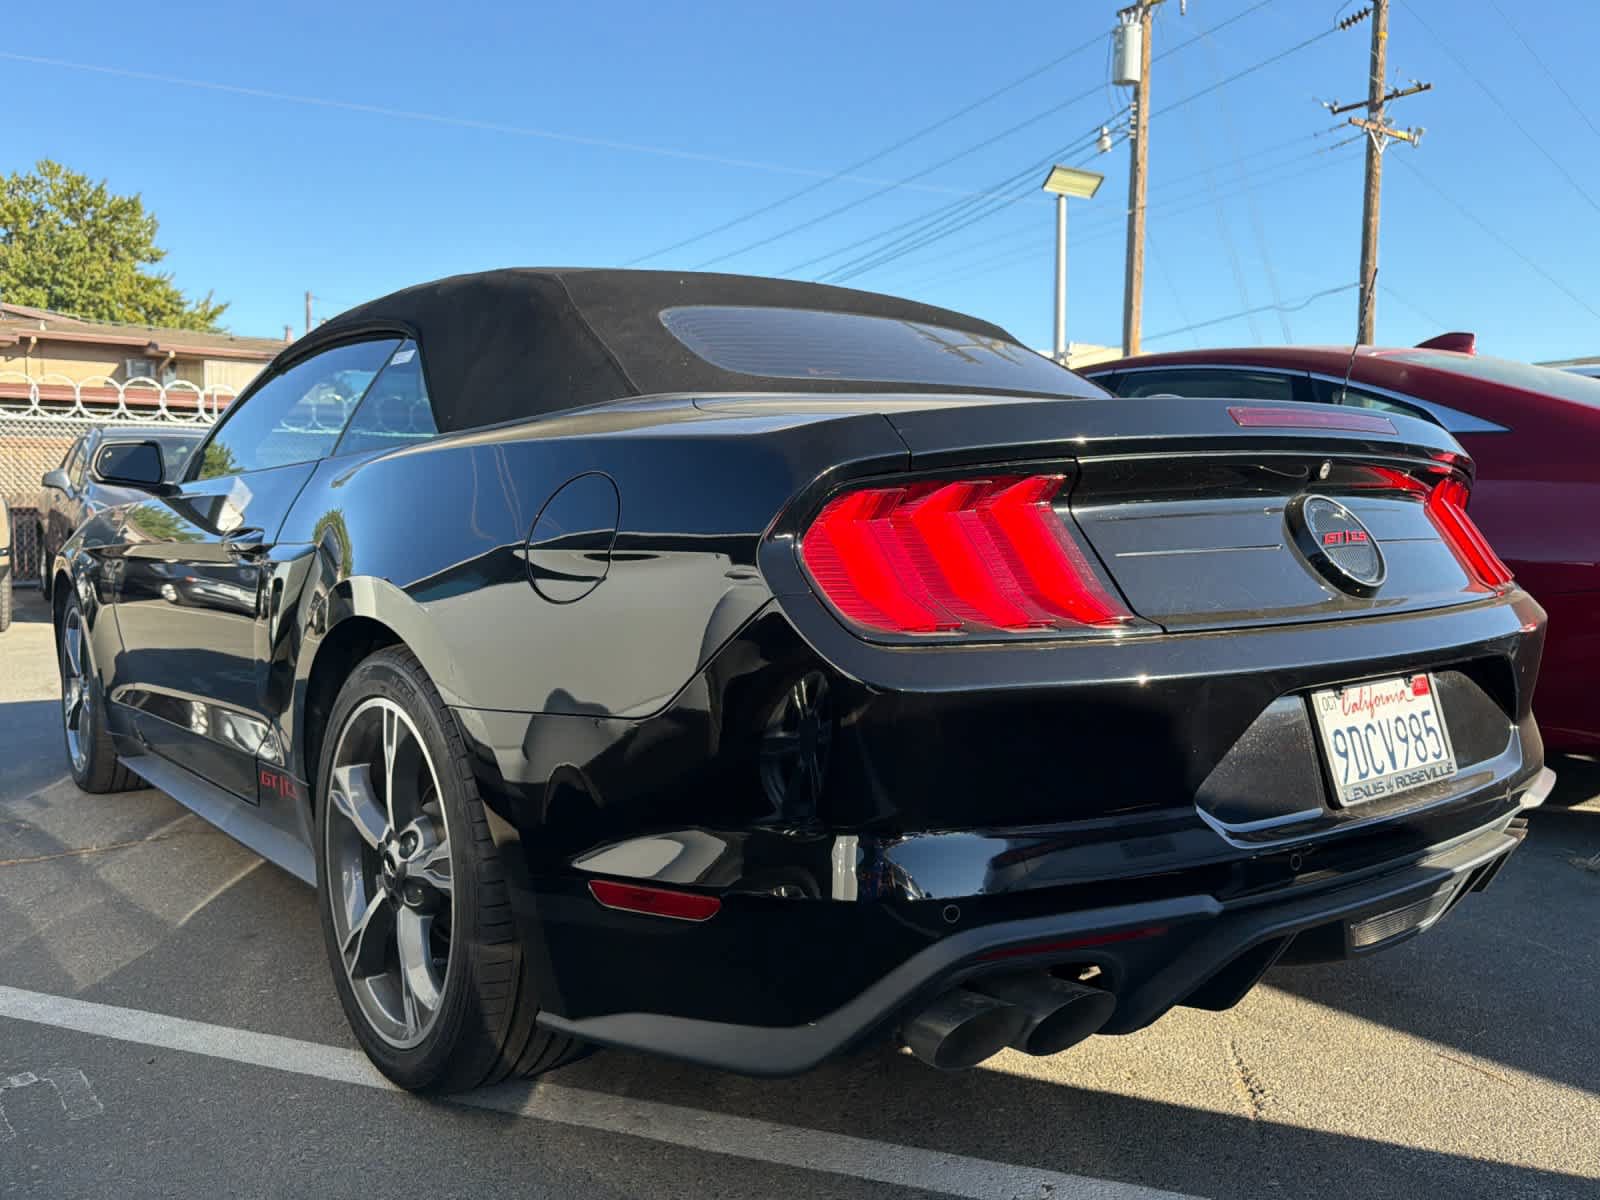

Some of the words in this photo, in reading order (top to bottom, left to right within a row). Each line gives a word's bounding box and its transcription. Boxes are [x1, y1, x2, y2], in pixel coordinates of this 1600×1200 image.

[1340, 687, 1414, 718] California
[1333, 710, 1443, 785] 9DCV985
[1344, 782, 1386, 803] LEXUS
[1395, 762, 1455, 789] ROSEVILLE
